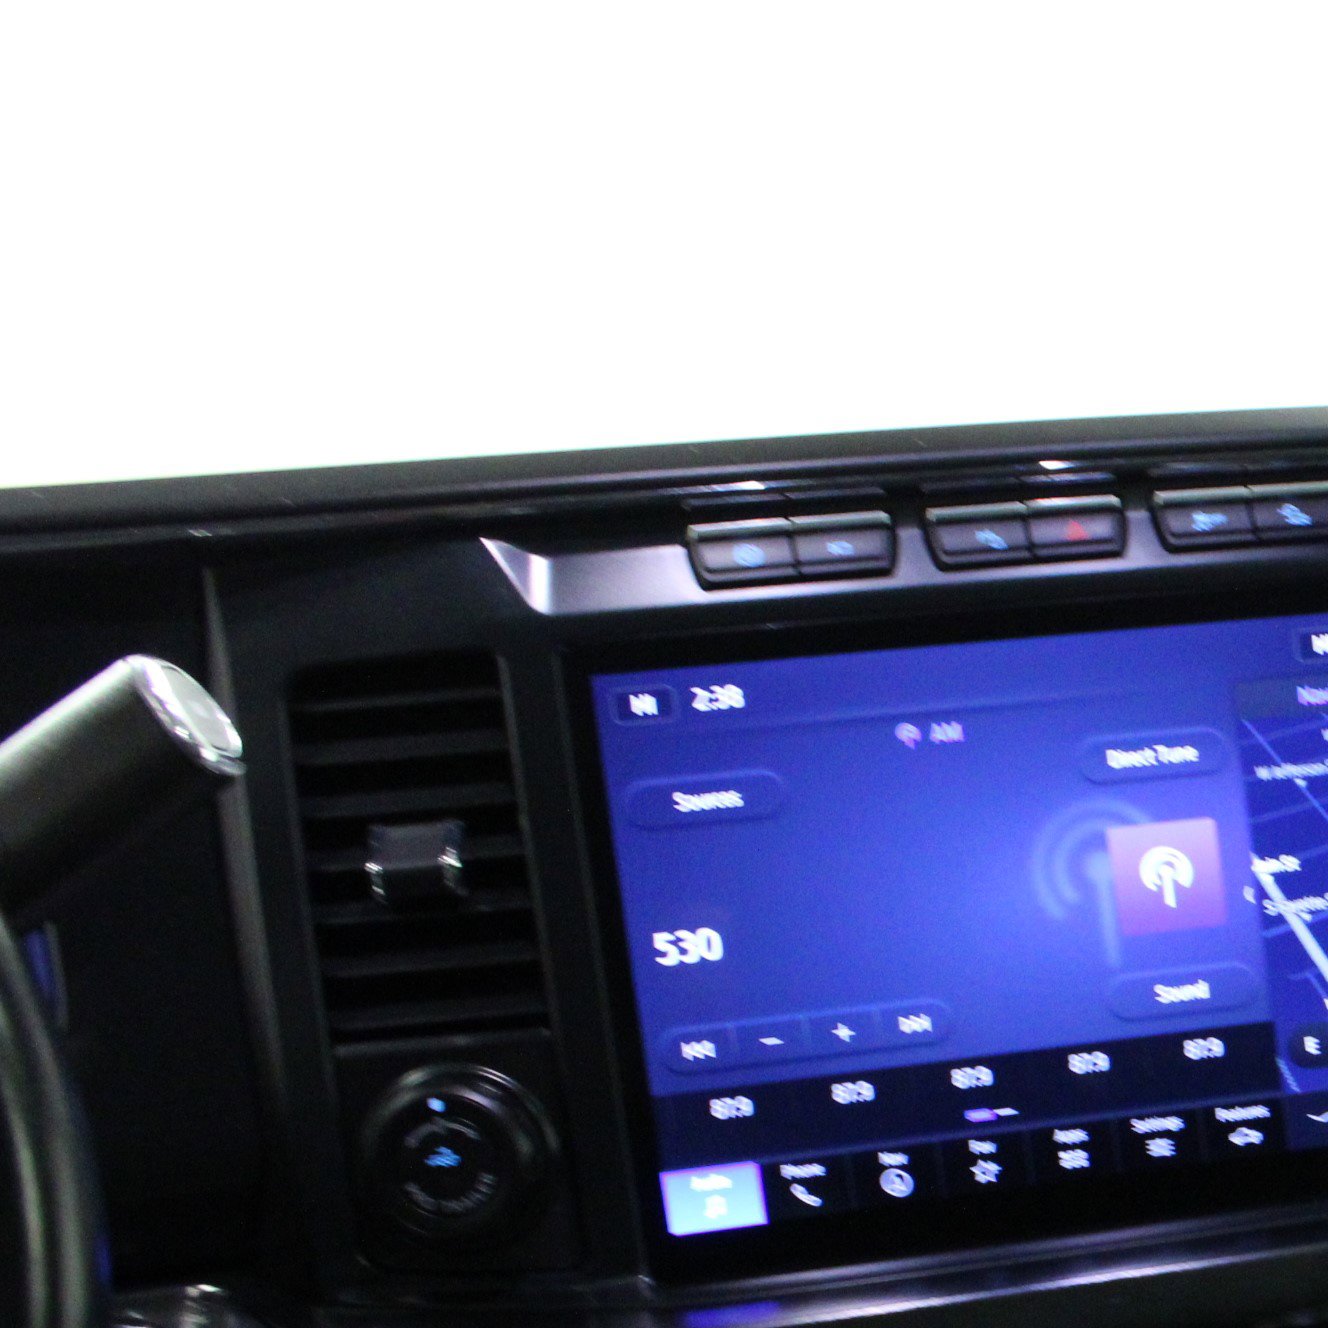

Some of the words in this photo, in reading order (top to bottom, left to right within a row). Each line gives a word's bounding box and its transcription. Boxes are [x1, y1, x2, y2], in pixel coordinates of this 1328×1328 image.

[1155, 743, 1199, 765] Tune
[652, 928, 725, 967] 530
[1153, 979, 1211, 1005] Sound
